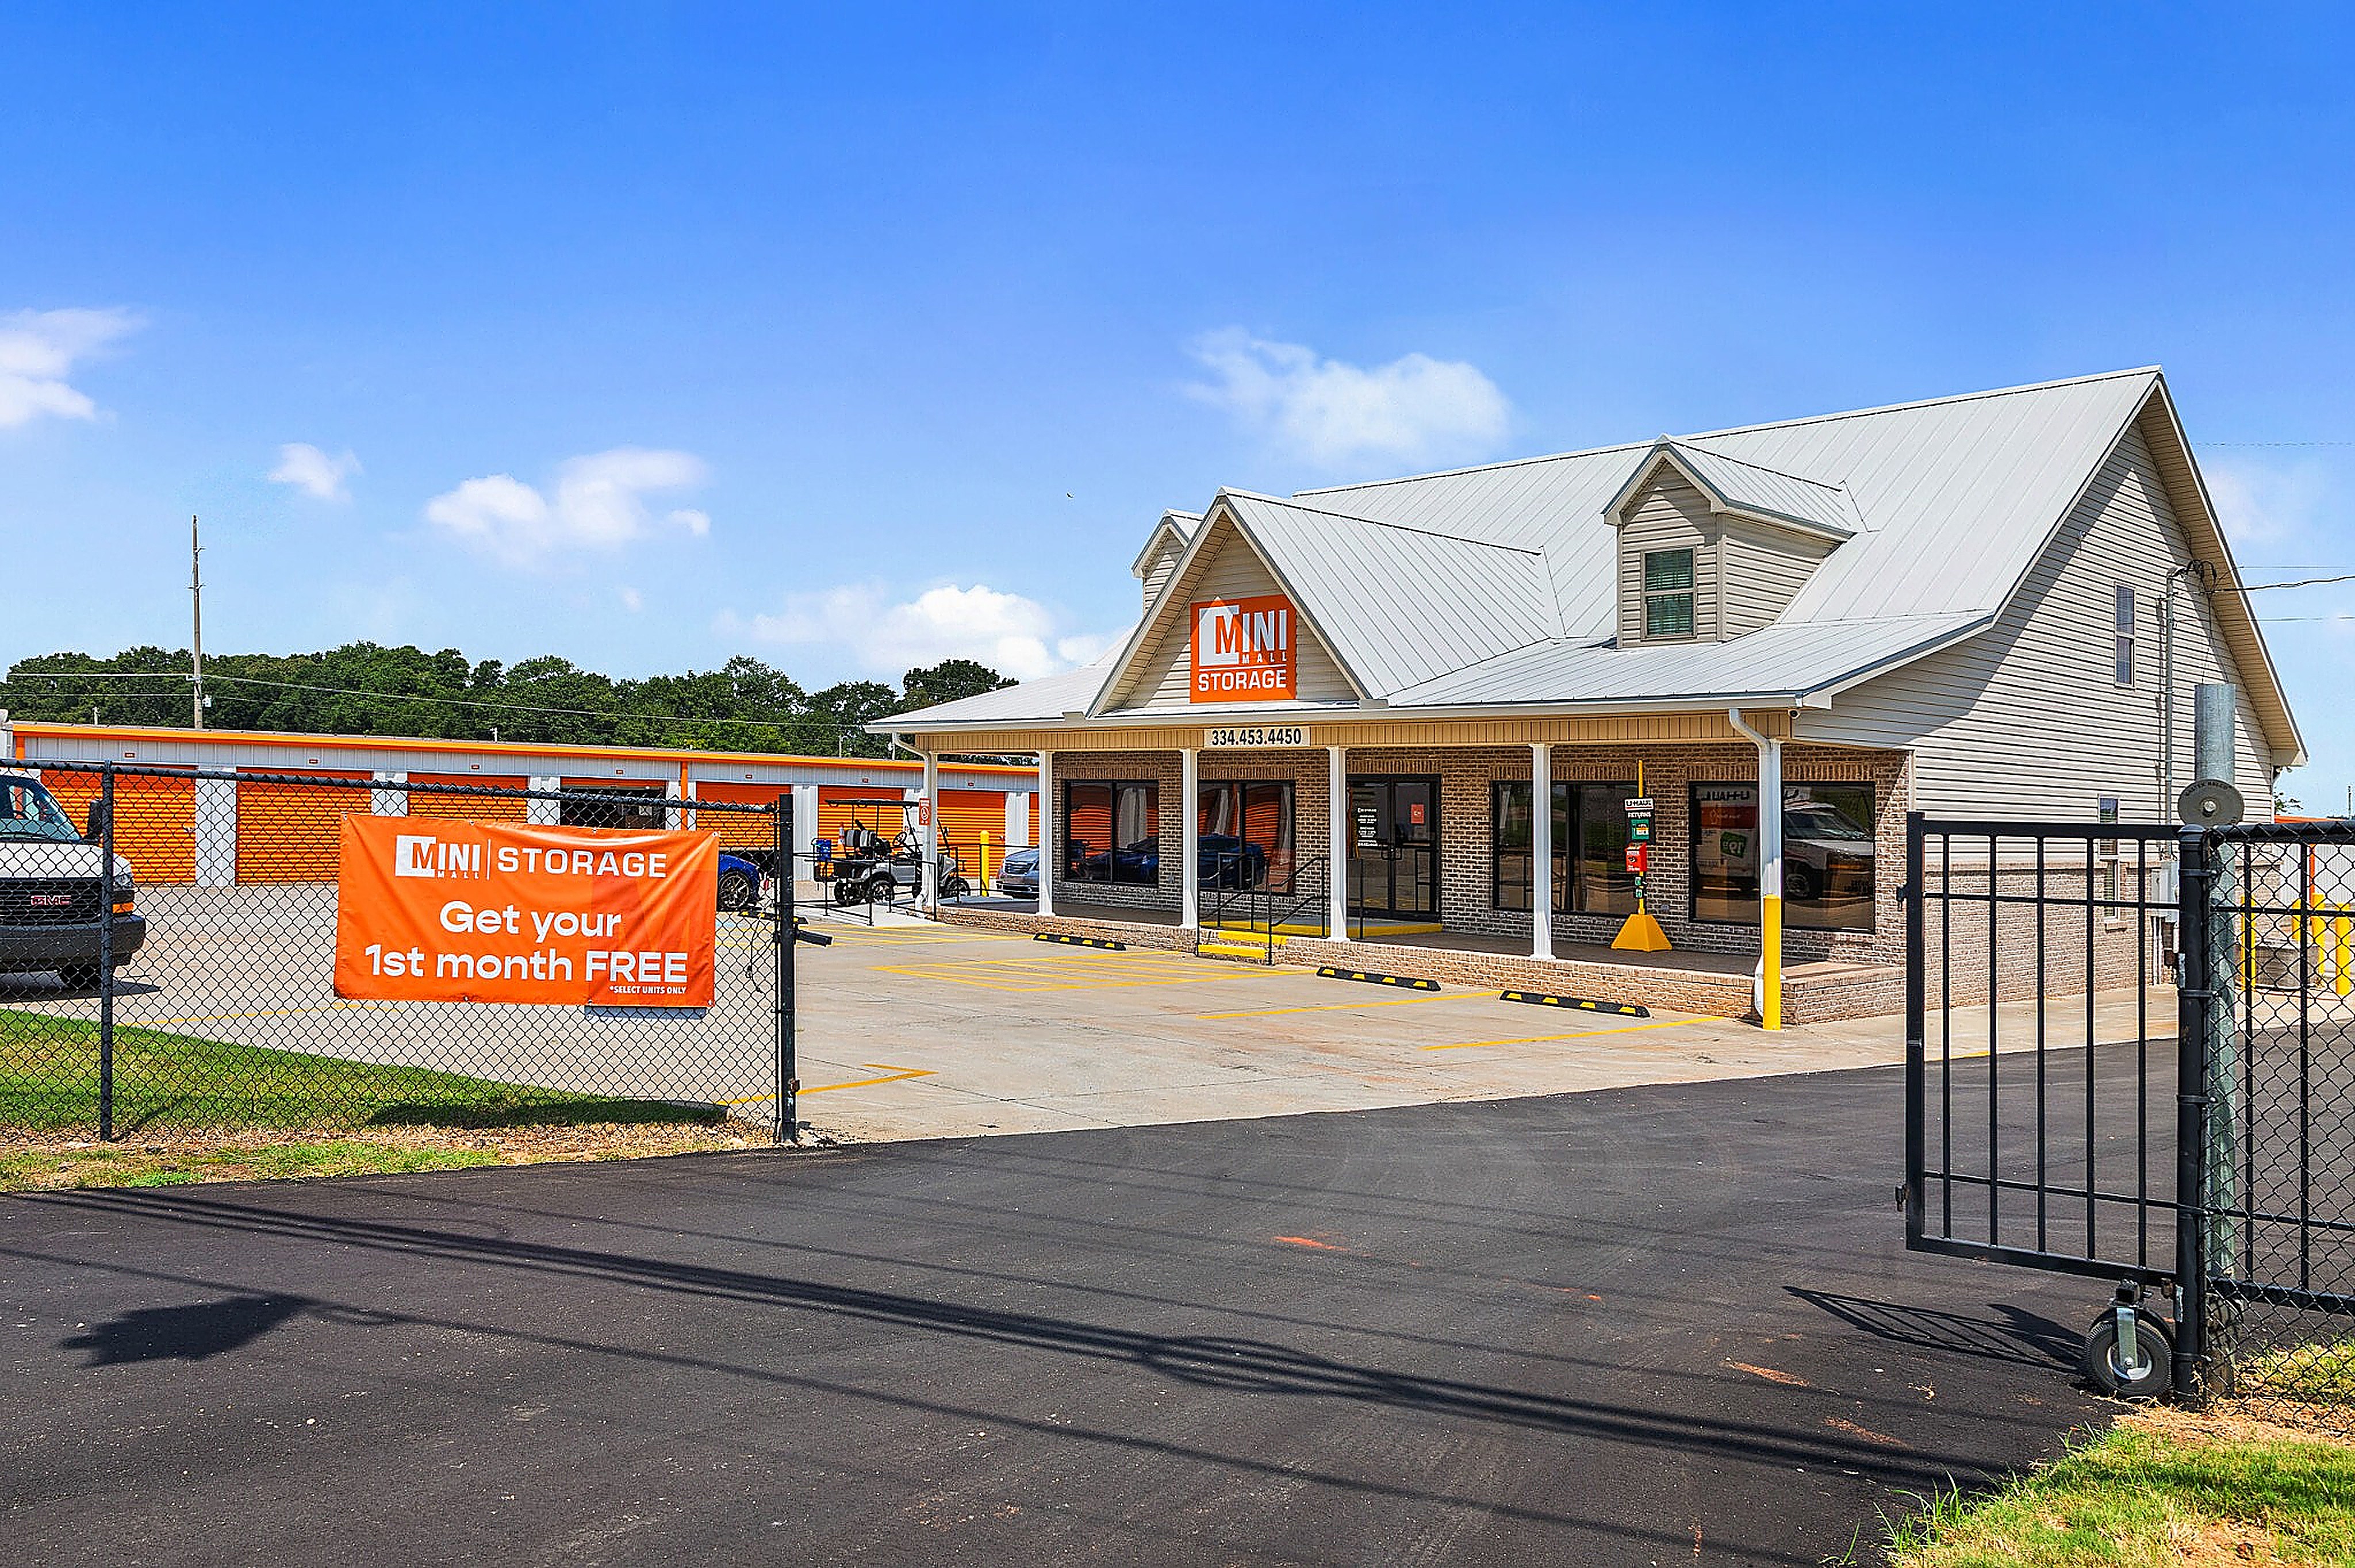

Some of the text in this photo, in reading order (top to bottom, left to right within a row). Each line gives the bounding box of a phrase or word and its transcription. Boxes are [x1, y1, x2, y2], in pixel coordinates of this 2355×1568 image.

[1210, 609, 1287, 656] MINI
[1242, 651, 1287, 664] MALL
[1198, 670, 1287, 691] STORAGE
[1211, 728, 1302, 746] 334.453.4450
[405, 840, 667, 878] MINI STORAGE
[437, 870, 480, 880] MALL
[439, 900, 622, 943] Get your
[365, 944, 688, 983] 1st month FREE
